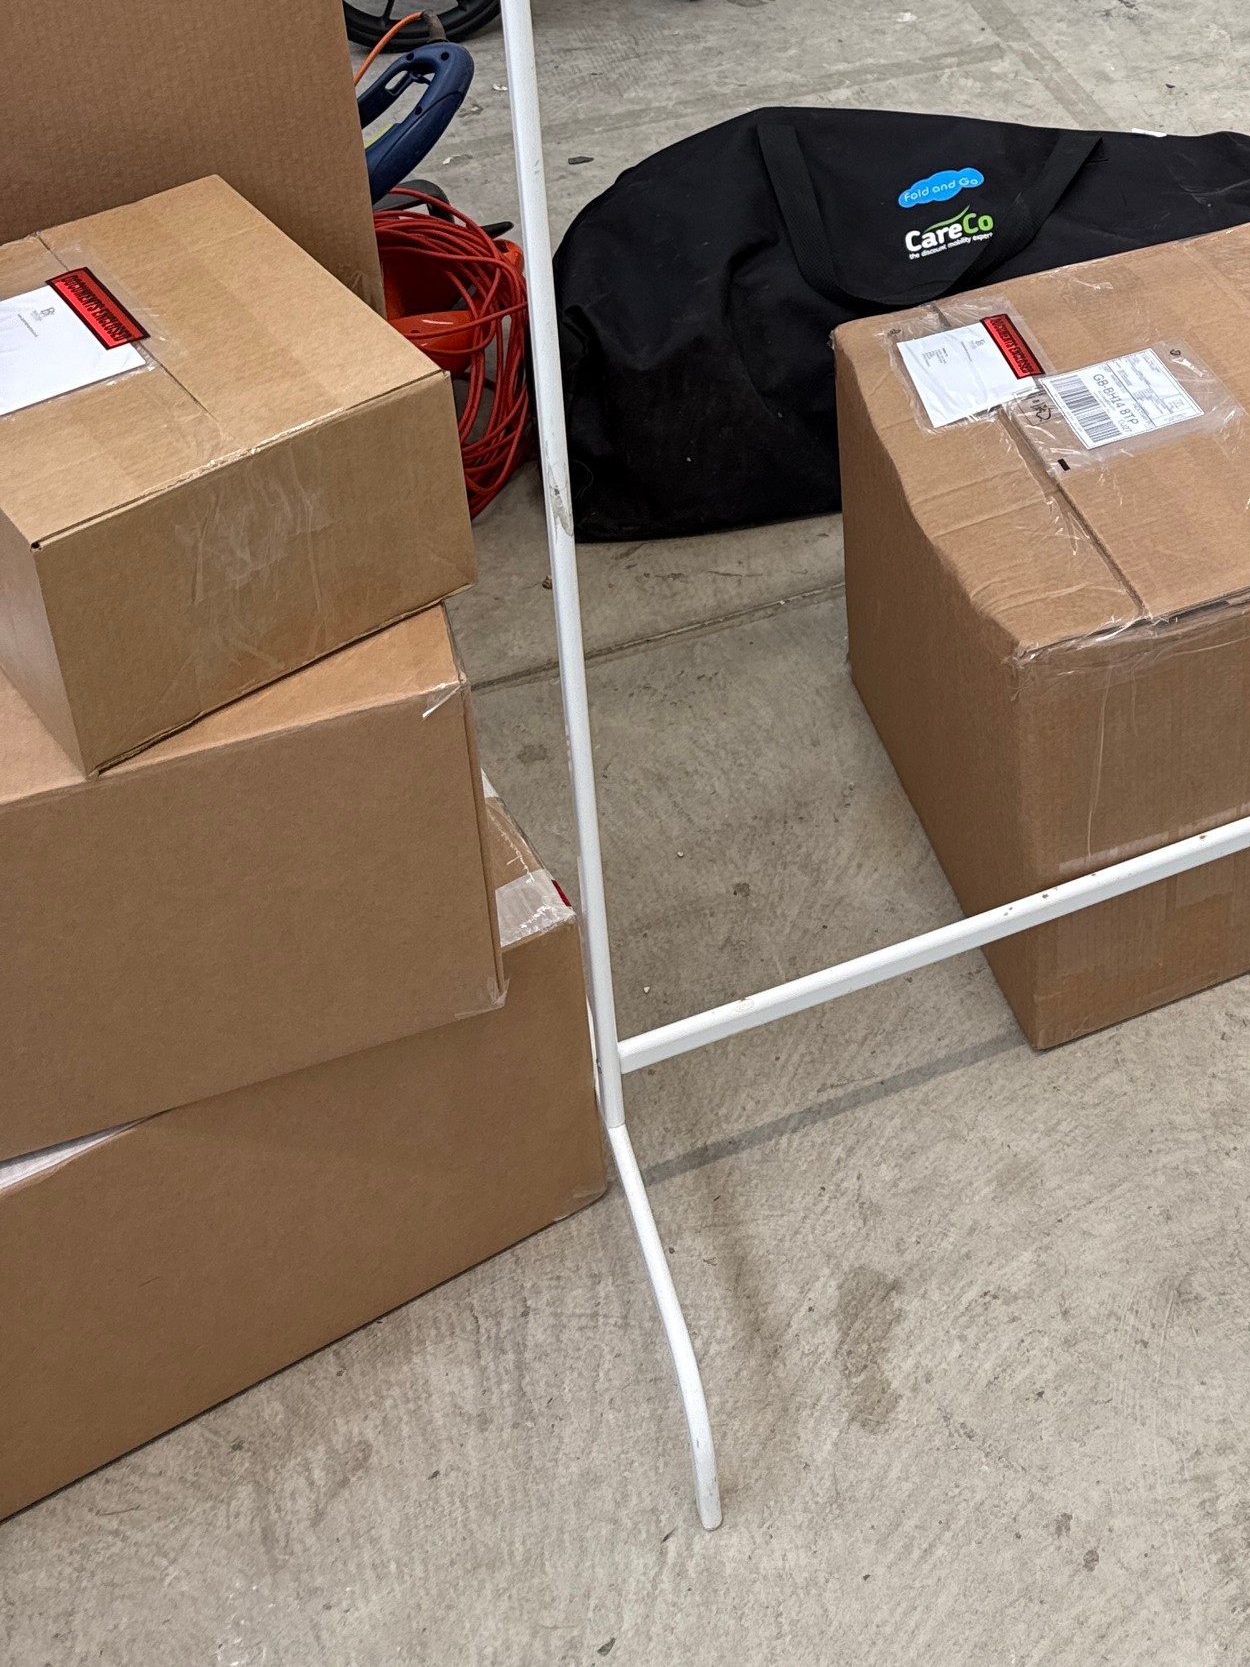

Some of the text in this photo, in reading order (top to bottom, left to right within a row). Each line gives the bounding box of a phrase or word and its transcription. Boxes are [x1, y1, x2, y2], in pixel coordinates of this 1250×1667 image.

[903, 177, 979, 203] Fold and Go
[904, 212, 995, 253] CareCo
[908, 252, 921, 261] the
[920, 243, 948, 258] discount
[946, 235, 972, 249] mobility
[1119, 407, 1139, 426] 8TP
